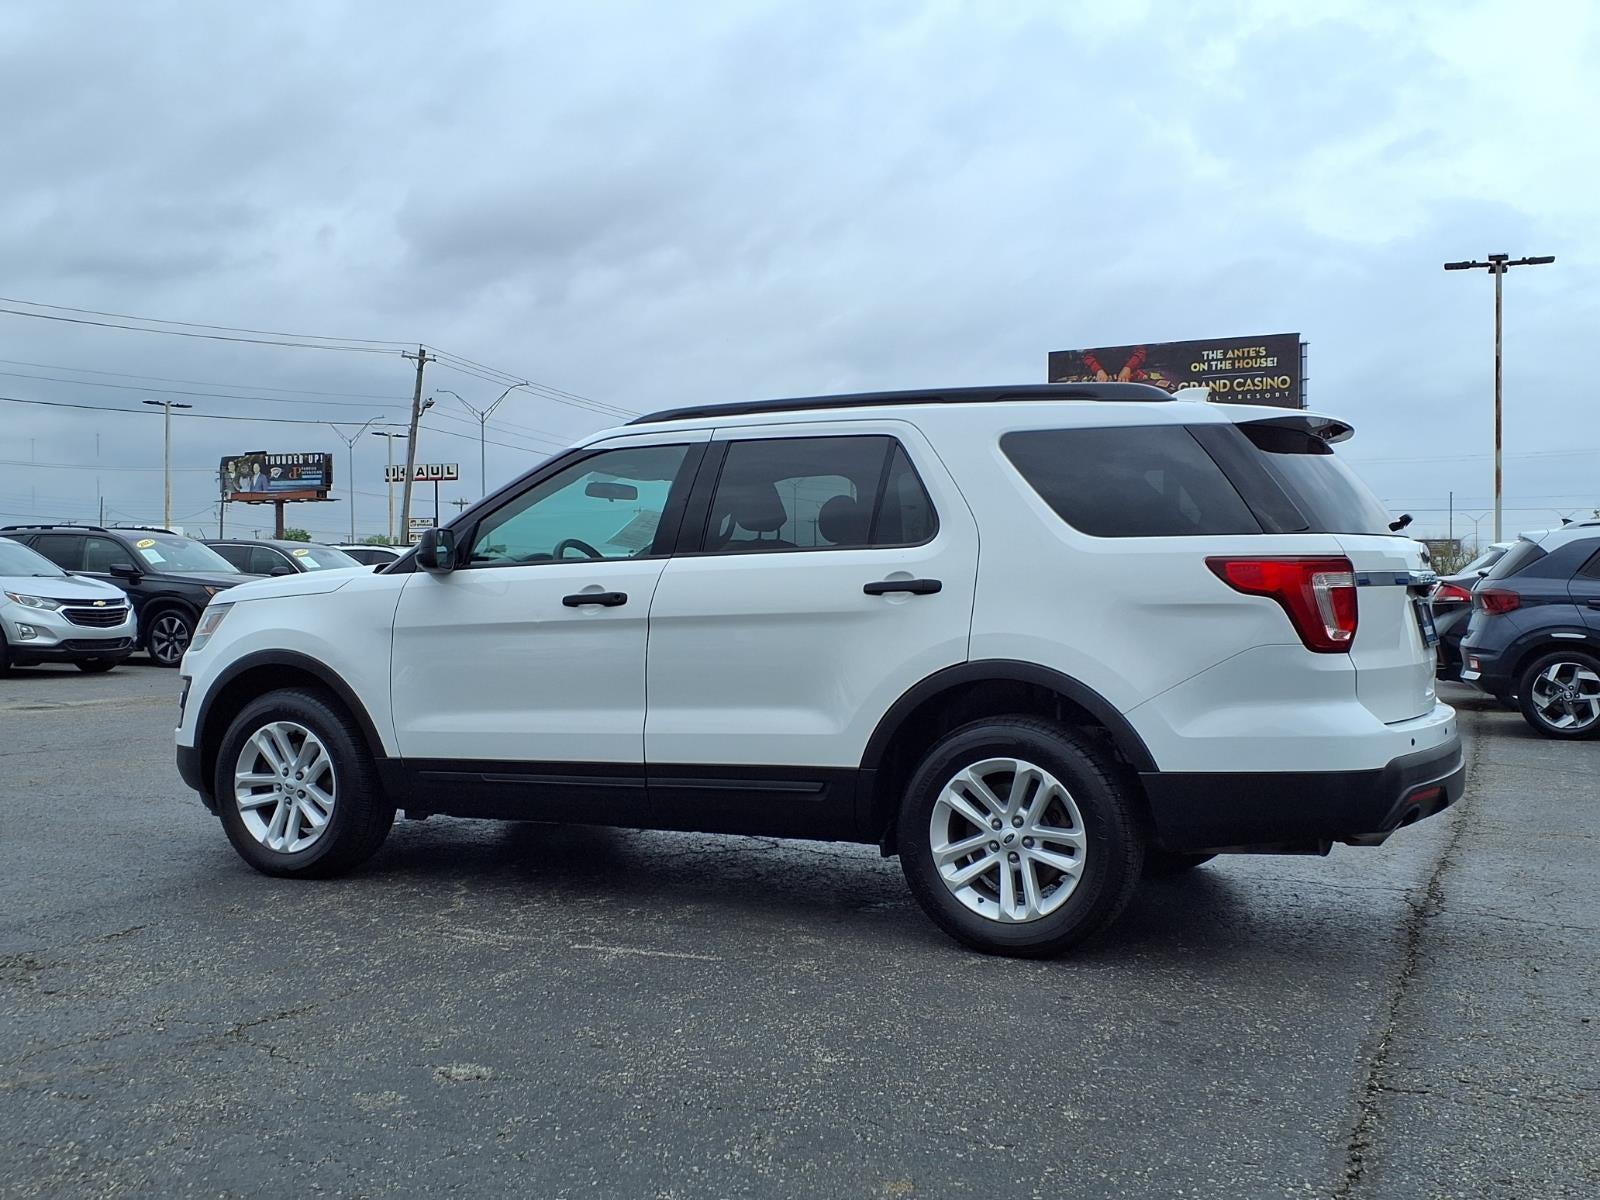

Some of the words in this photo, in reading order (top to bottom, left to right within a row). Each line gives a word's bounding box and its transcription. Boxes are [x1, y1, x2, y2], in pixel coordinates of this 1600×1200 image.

[1202, 350, 1224, 360] THE
[1226, 347, 1266, 359] ANTE'S
[1190, 362, 1208, 372] ON
[1210, 360, 1232, 371] THE
[1235, 357, 1278, 369] HOUSE!
[1233, 375, 1291, 392] CASINO
[1237, 391, 1290, 400] RESORT
